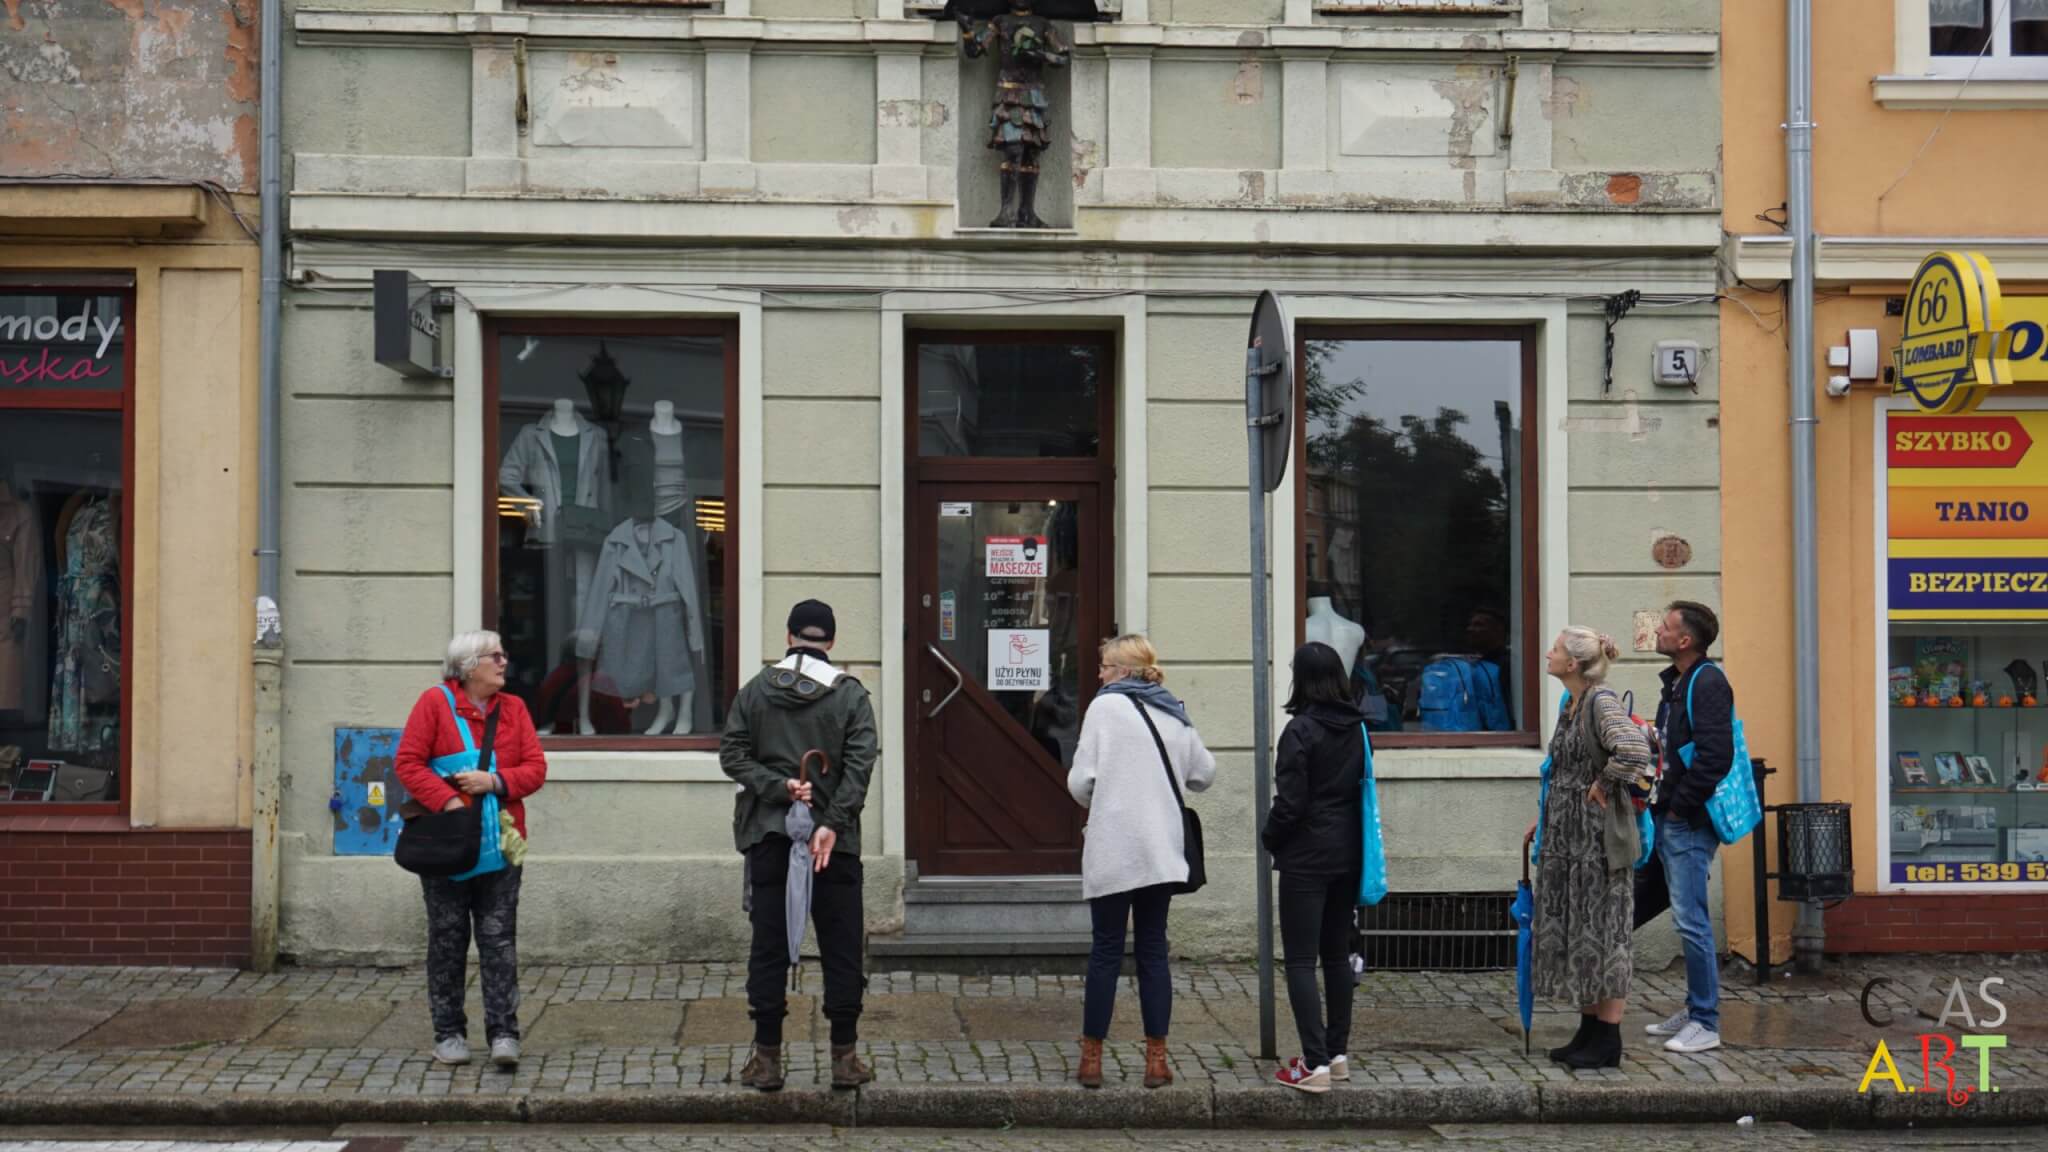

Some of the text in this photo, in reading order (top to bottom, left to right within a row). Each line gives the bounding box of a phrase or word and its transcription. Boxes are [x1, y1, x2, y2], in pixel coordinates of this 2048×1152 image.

[1917, 277, 1949, 326] 66
[0, 299, 121, 359] mody
[1672, 350, 1686, 371] 5
[1905, 339, 1964, 365] LOMBARD
[1895, 431, 2012, 451] SZYBKO
[1935, 502, 2029, 521] TANIO
[989, 562, 1043, 575] MASECZCE
[1909, 572, 2048, 593] BEZPIECZ
[995, 665, 1042, 678] UŻYJ PŁYNU
[1905, 862, 2048, 882] tel: 539 5
